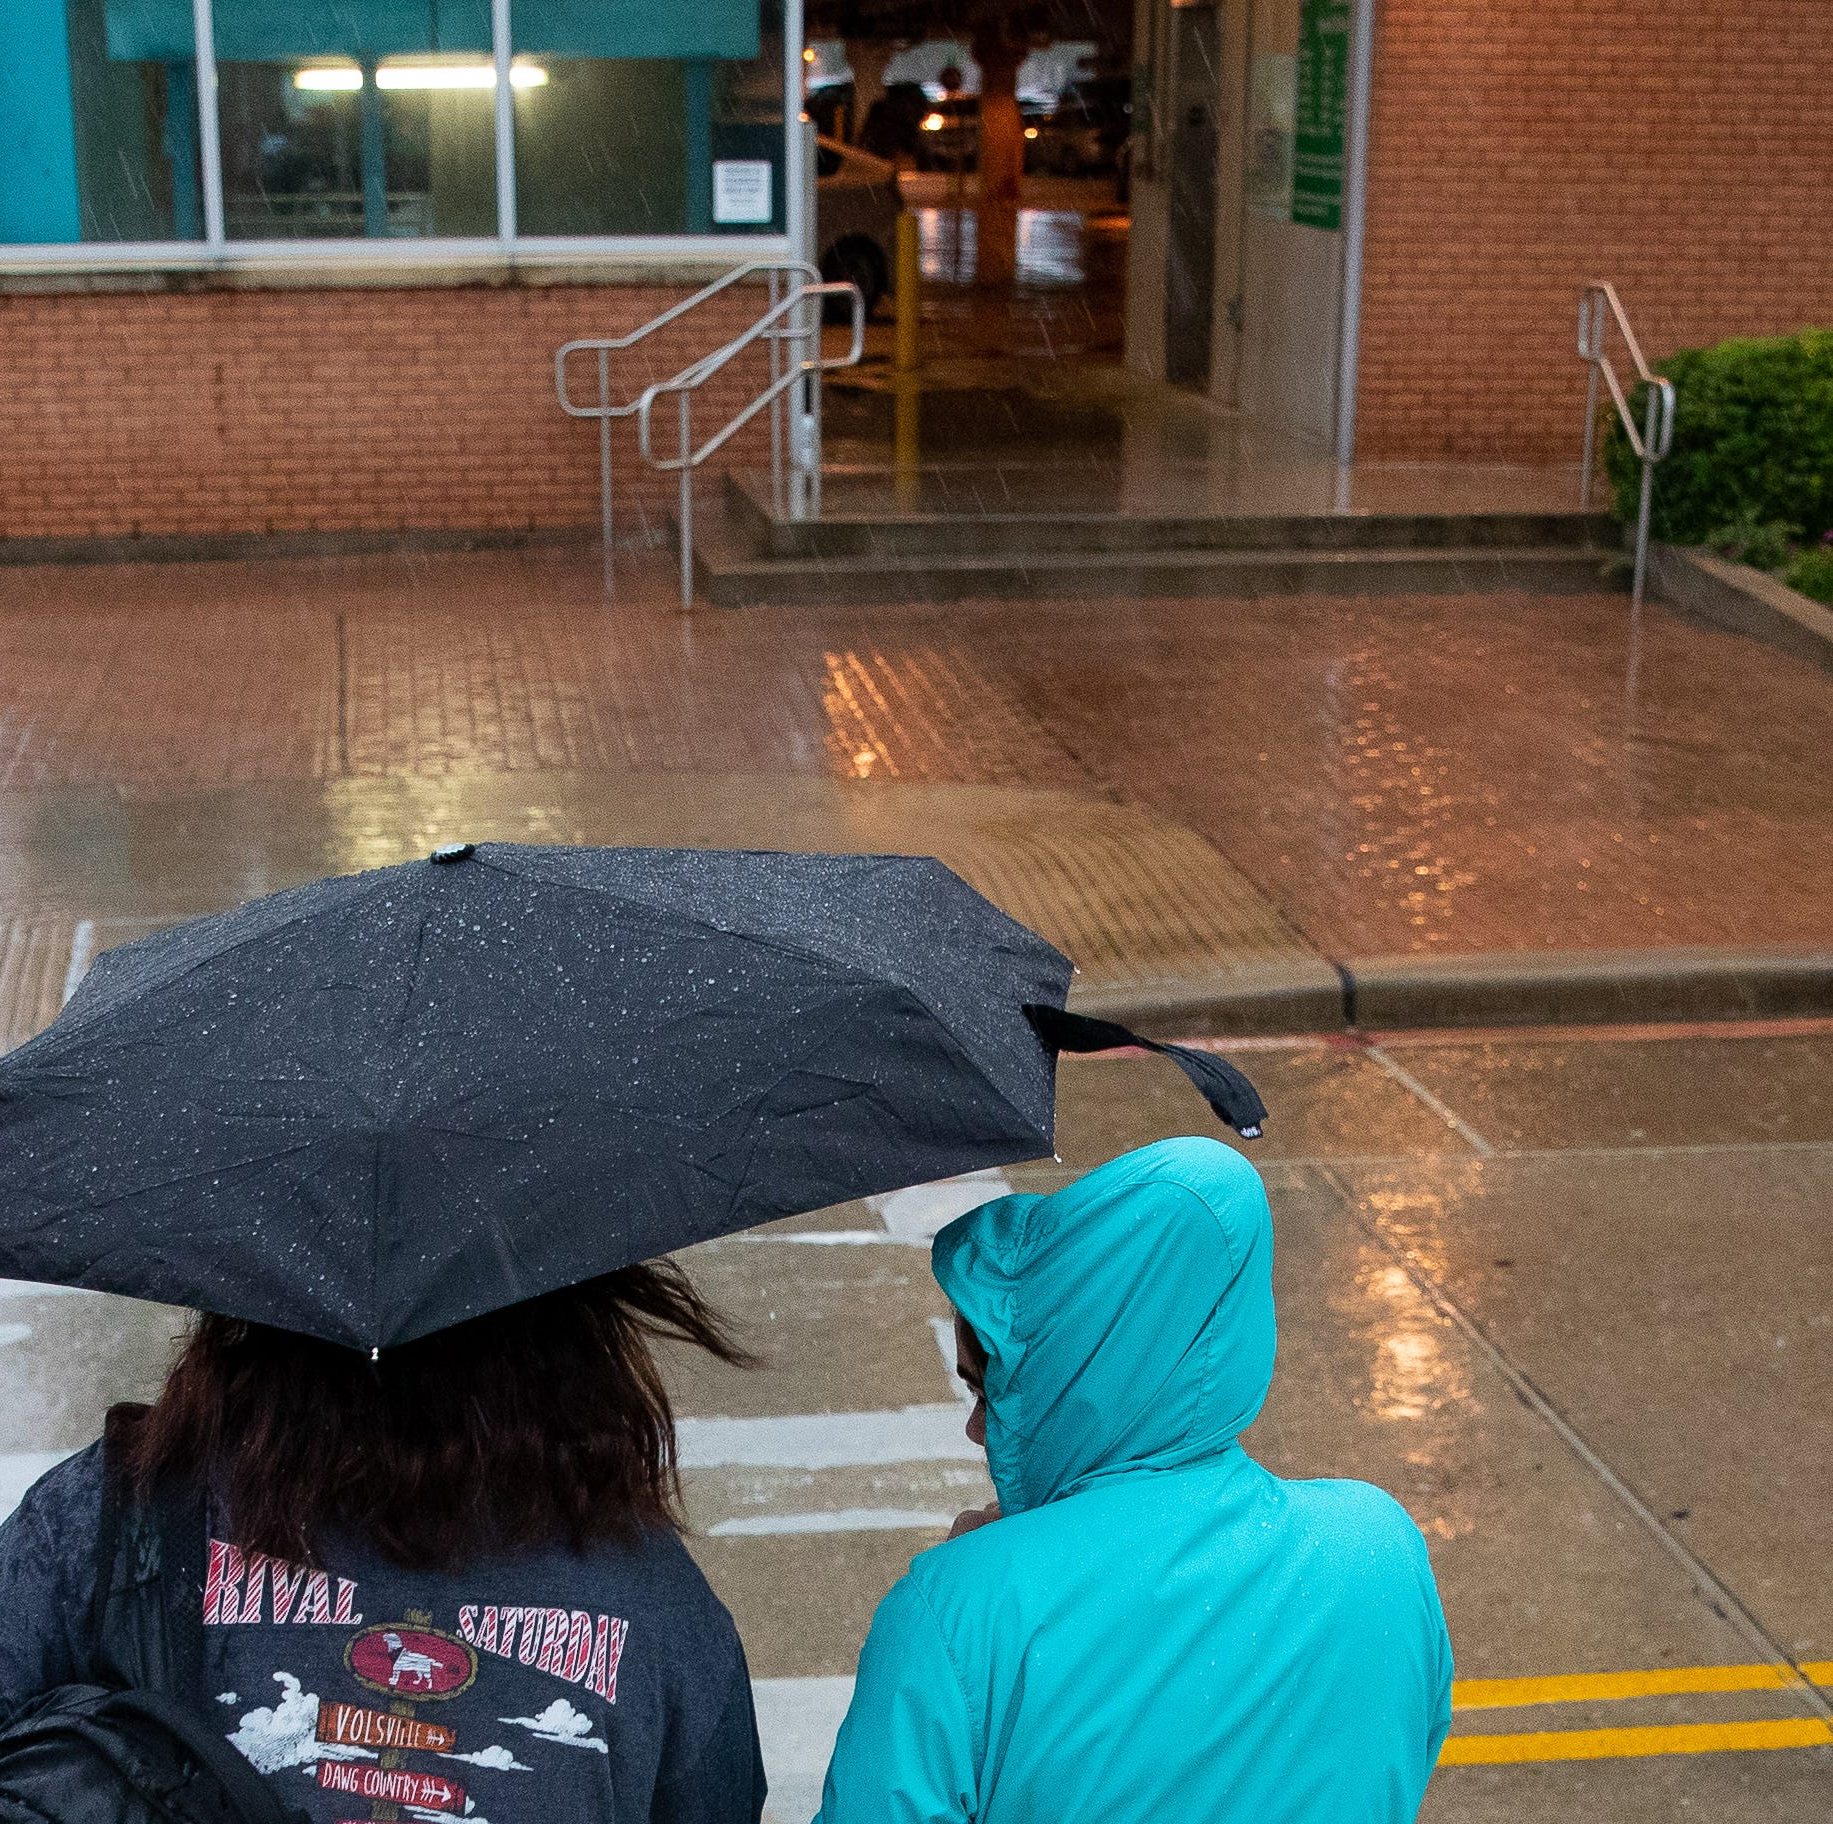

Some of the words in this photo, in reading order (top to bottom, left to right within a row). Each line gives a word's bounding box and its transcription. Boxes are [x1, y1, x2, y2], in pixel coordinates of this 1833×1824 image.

[203, 1538, 363, 1625] RIVAL
[456, 1605, 629, 1704] SATURDAY
[336, 1705, 422, 1747] VOLSVILLE
[322, 1761, 359, 1793] DAWG
[364, 1769, 419, 1801] COUNTRY
